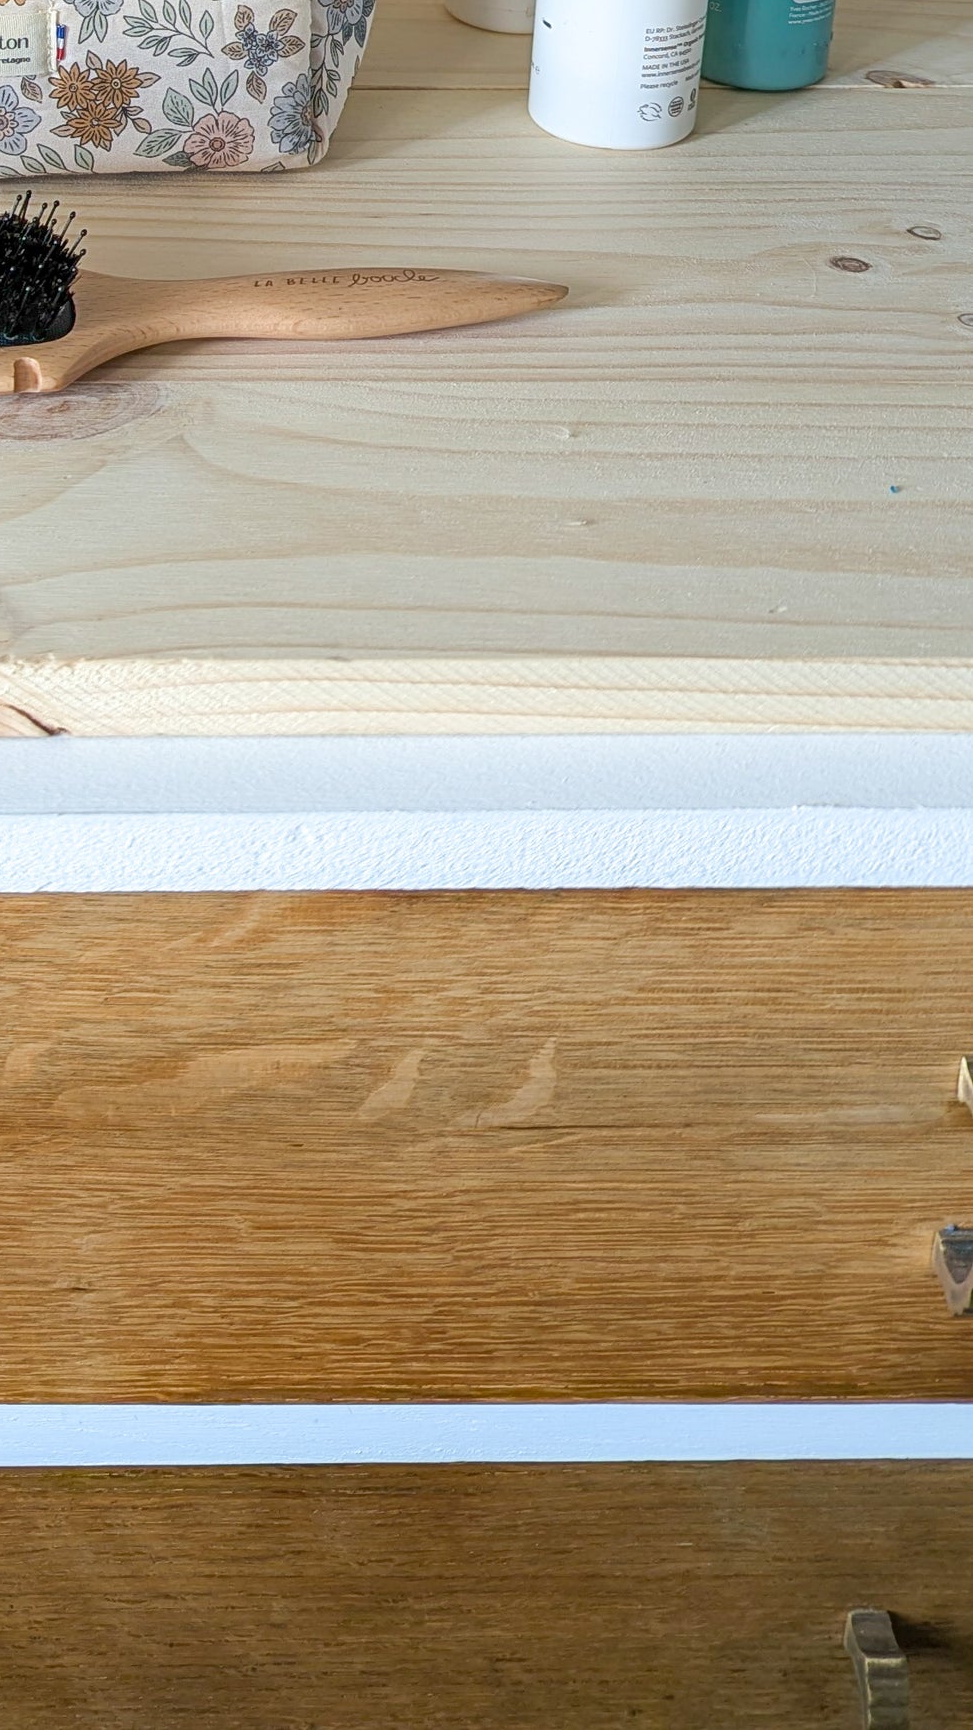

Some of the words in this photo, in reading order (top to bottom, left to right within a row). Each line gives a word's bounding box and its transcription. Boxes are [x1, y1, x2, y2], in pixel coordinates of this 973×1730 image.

[253, 279, 274, 288] LA
[286, 275, 340, 286] BELLE
[348, 269, 440, 288] boucle
